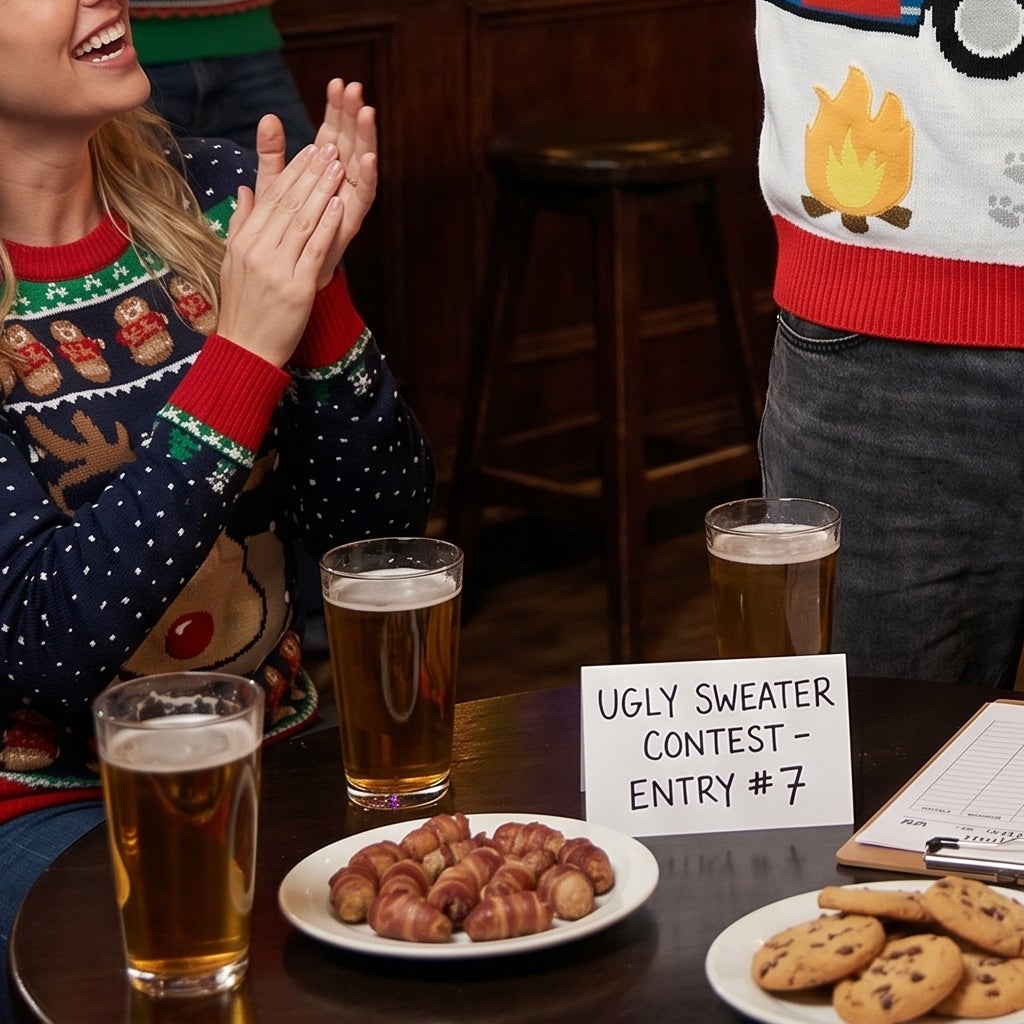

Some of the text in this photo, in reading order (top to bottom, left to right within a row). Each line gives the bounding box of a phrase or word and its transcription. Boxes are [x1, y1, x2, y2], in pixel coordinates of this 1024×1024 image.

[598, 676, 835, 720] UGLY SWEATER
[643, 724, 785, 761] CONTEST
[630, 772, 735, 811] ENTRY
